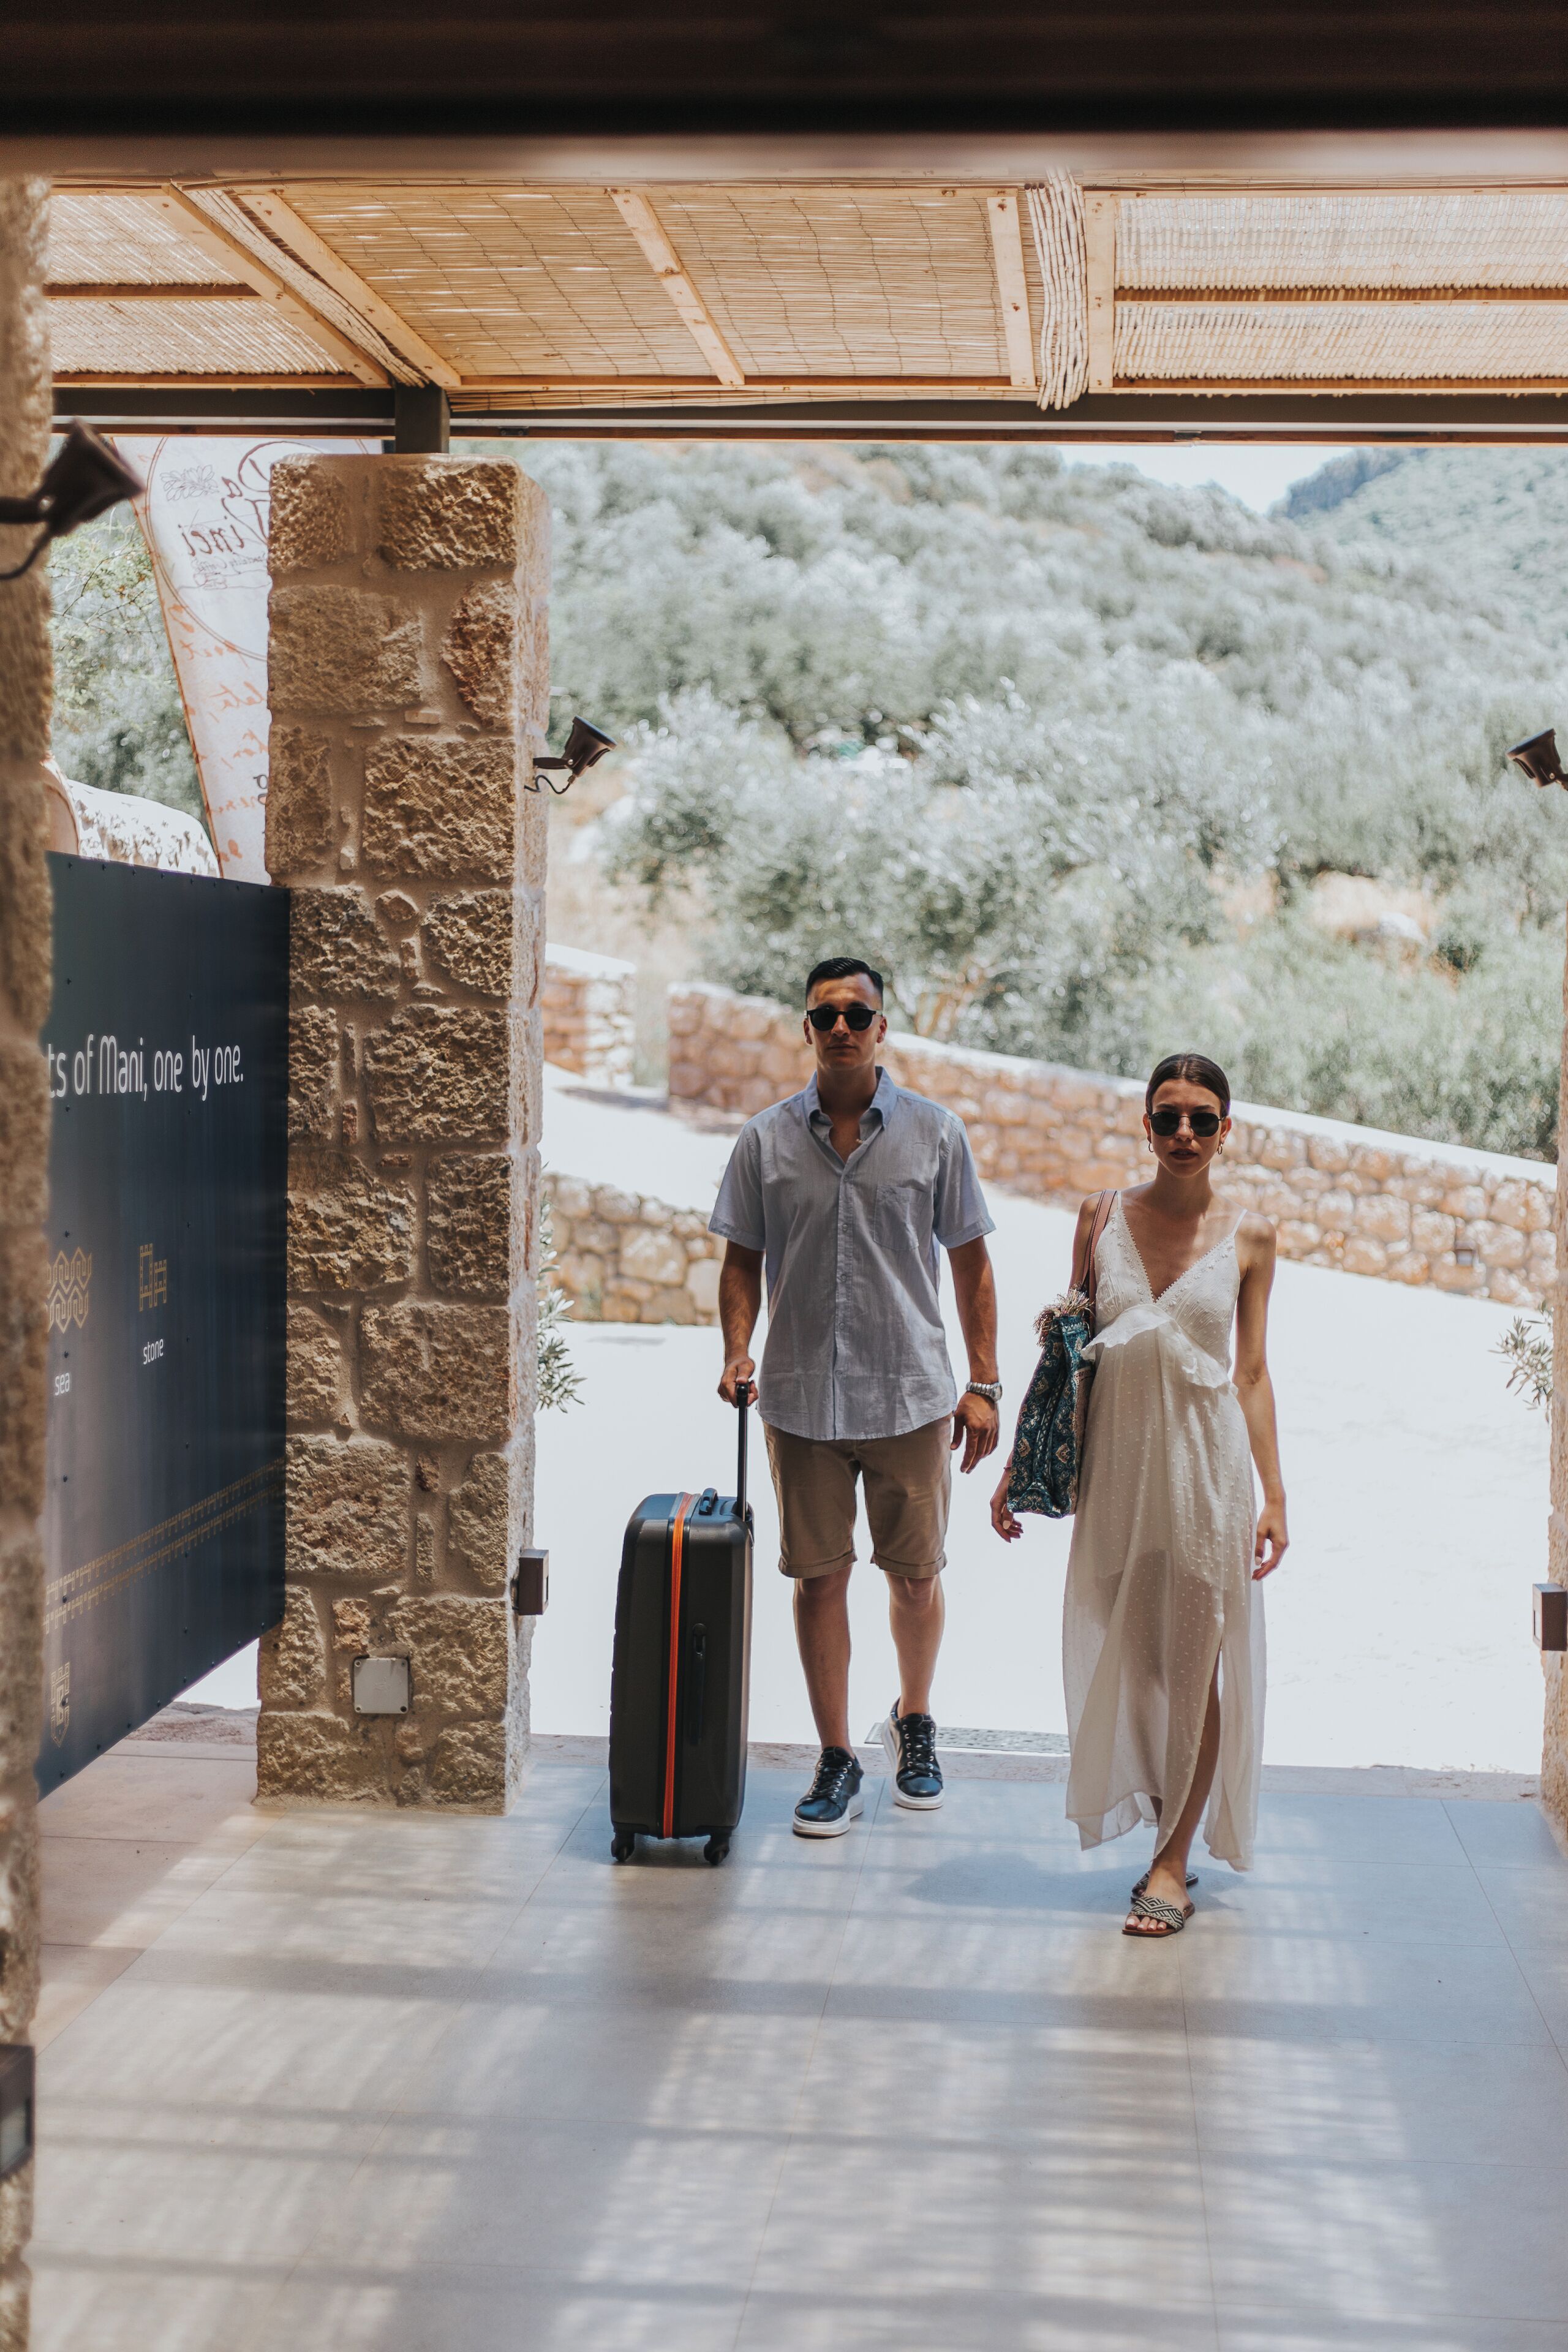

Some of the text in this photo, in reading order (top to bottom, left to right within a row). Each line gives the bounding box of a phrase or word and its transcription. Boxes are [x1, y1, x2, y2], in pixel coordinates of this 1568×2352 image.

[74, 1033, 94, 1095] of
[99, 1035, 147, 1102] Mani,
[154, 1050, 183, 1093] one
[192, 1035, 210, 1102] by
[214, 1044, 244, 1085] one.
[143, 1338, 164, 1365] stone
[54, 1371, 70, 1396] sea
